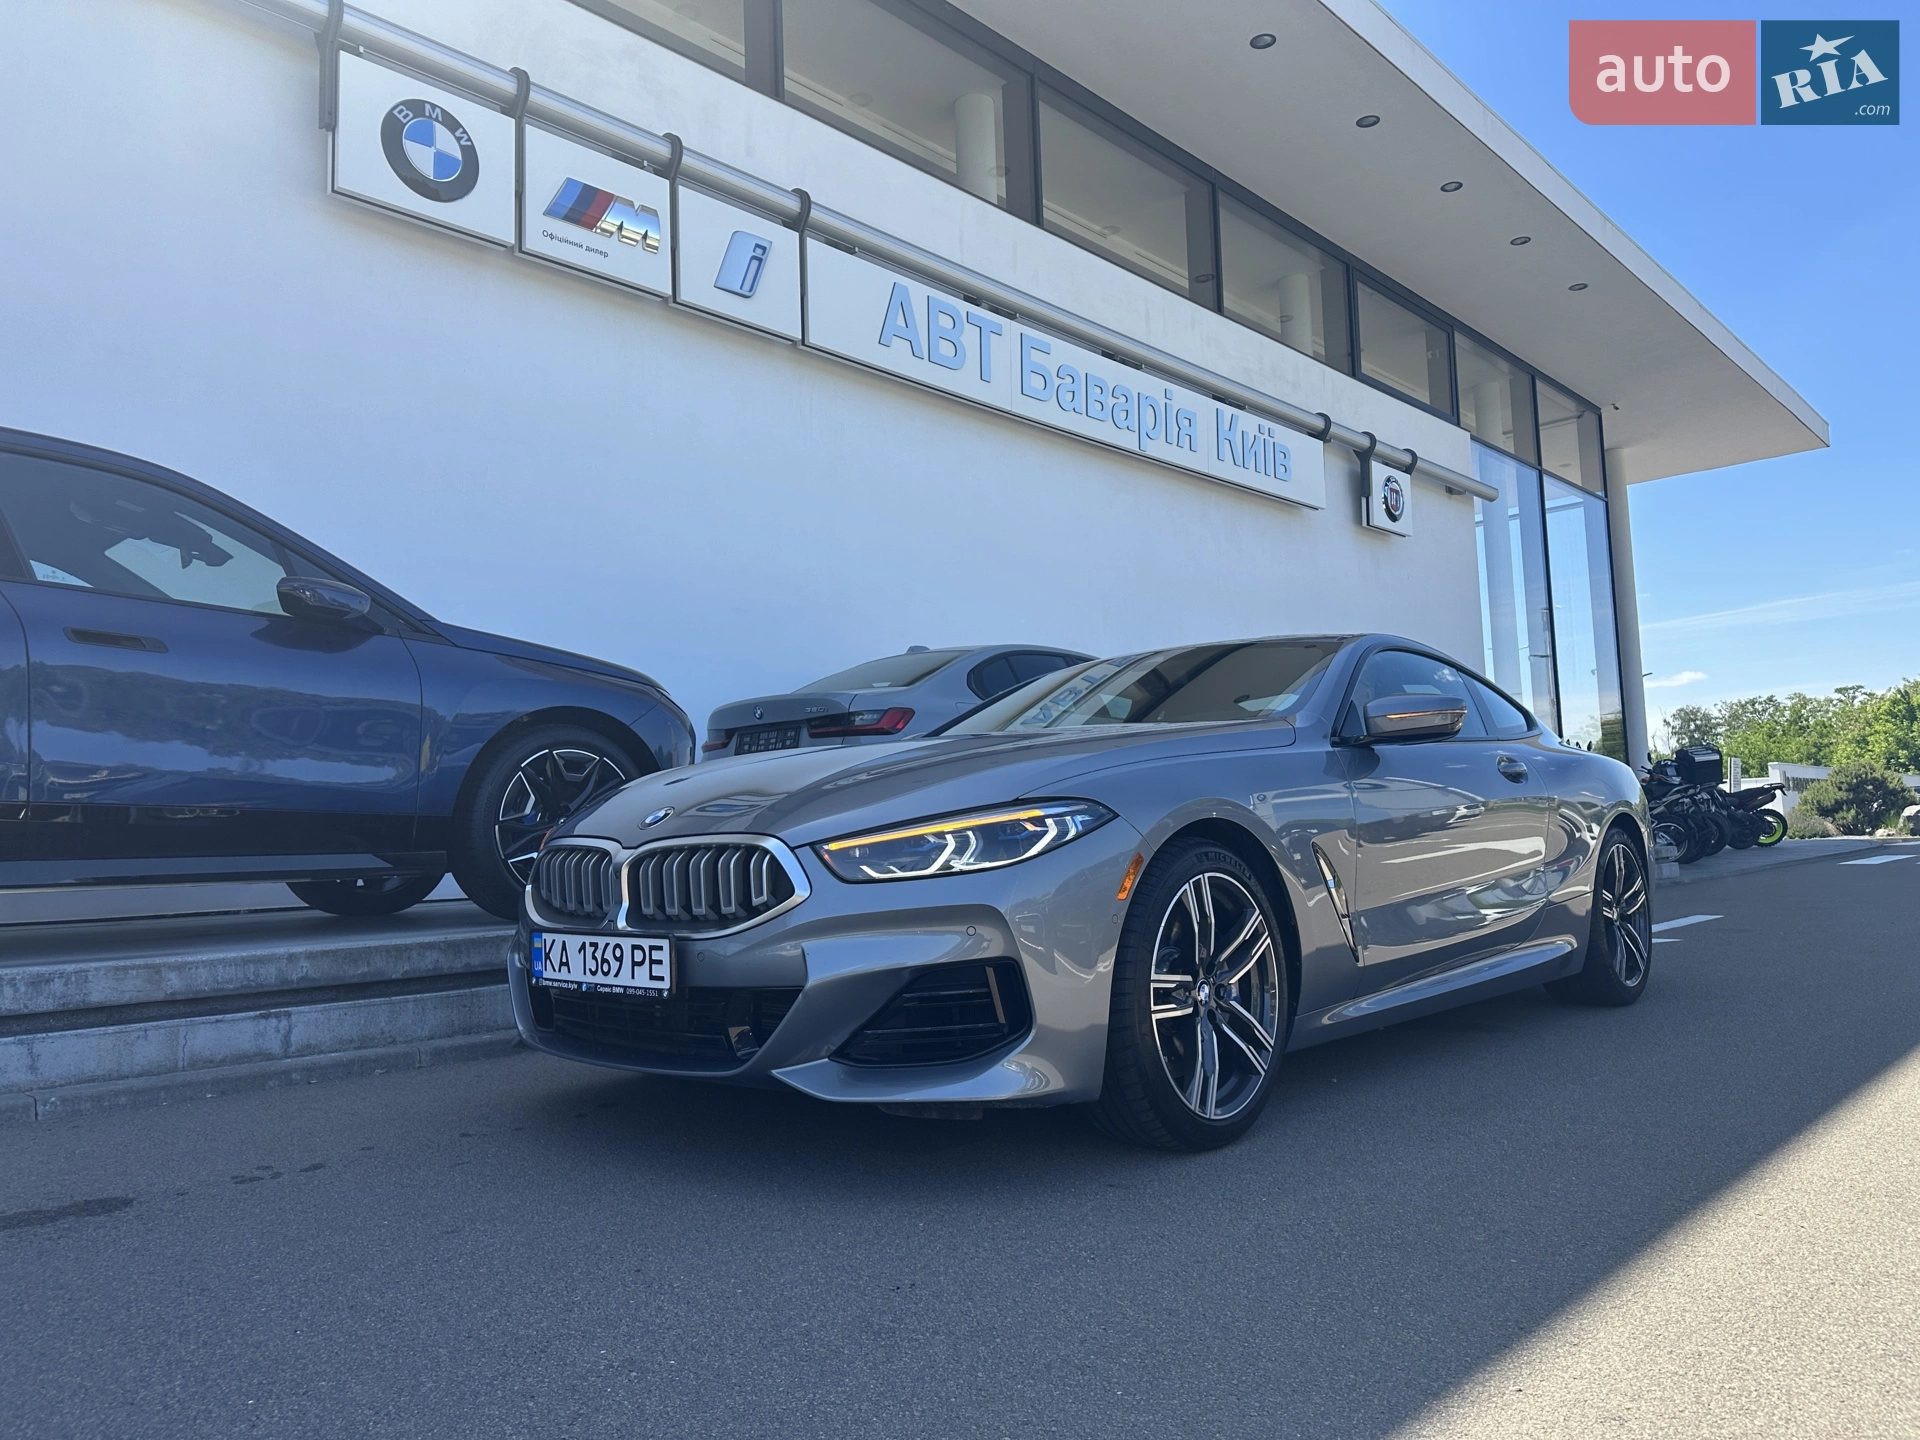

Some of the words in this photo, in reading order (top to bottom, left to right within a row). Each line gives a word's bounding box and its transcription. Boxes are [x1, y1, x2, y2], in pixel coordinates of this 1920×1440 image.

[392, 103, 472, 147] BMW
[542, 229, 583, 249] Офіційний
[585, 245, 609, 258] дилер
[878, 281, 1003, 383] АВТ
[1020, 332, 1198, 452] Баварія
[1216, 407, 1292, 482] Київ
[1208, 851, 1251, 878] MICHELIN
[534, 961, 542, 971] UA
[543, 938, 571, 974] KA
[578, 941, 624, 978] 1369
[630, 943, 665, 981] PE
[612, 986, 624, 994] BMW
